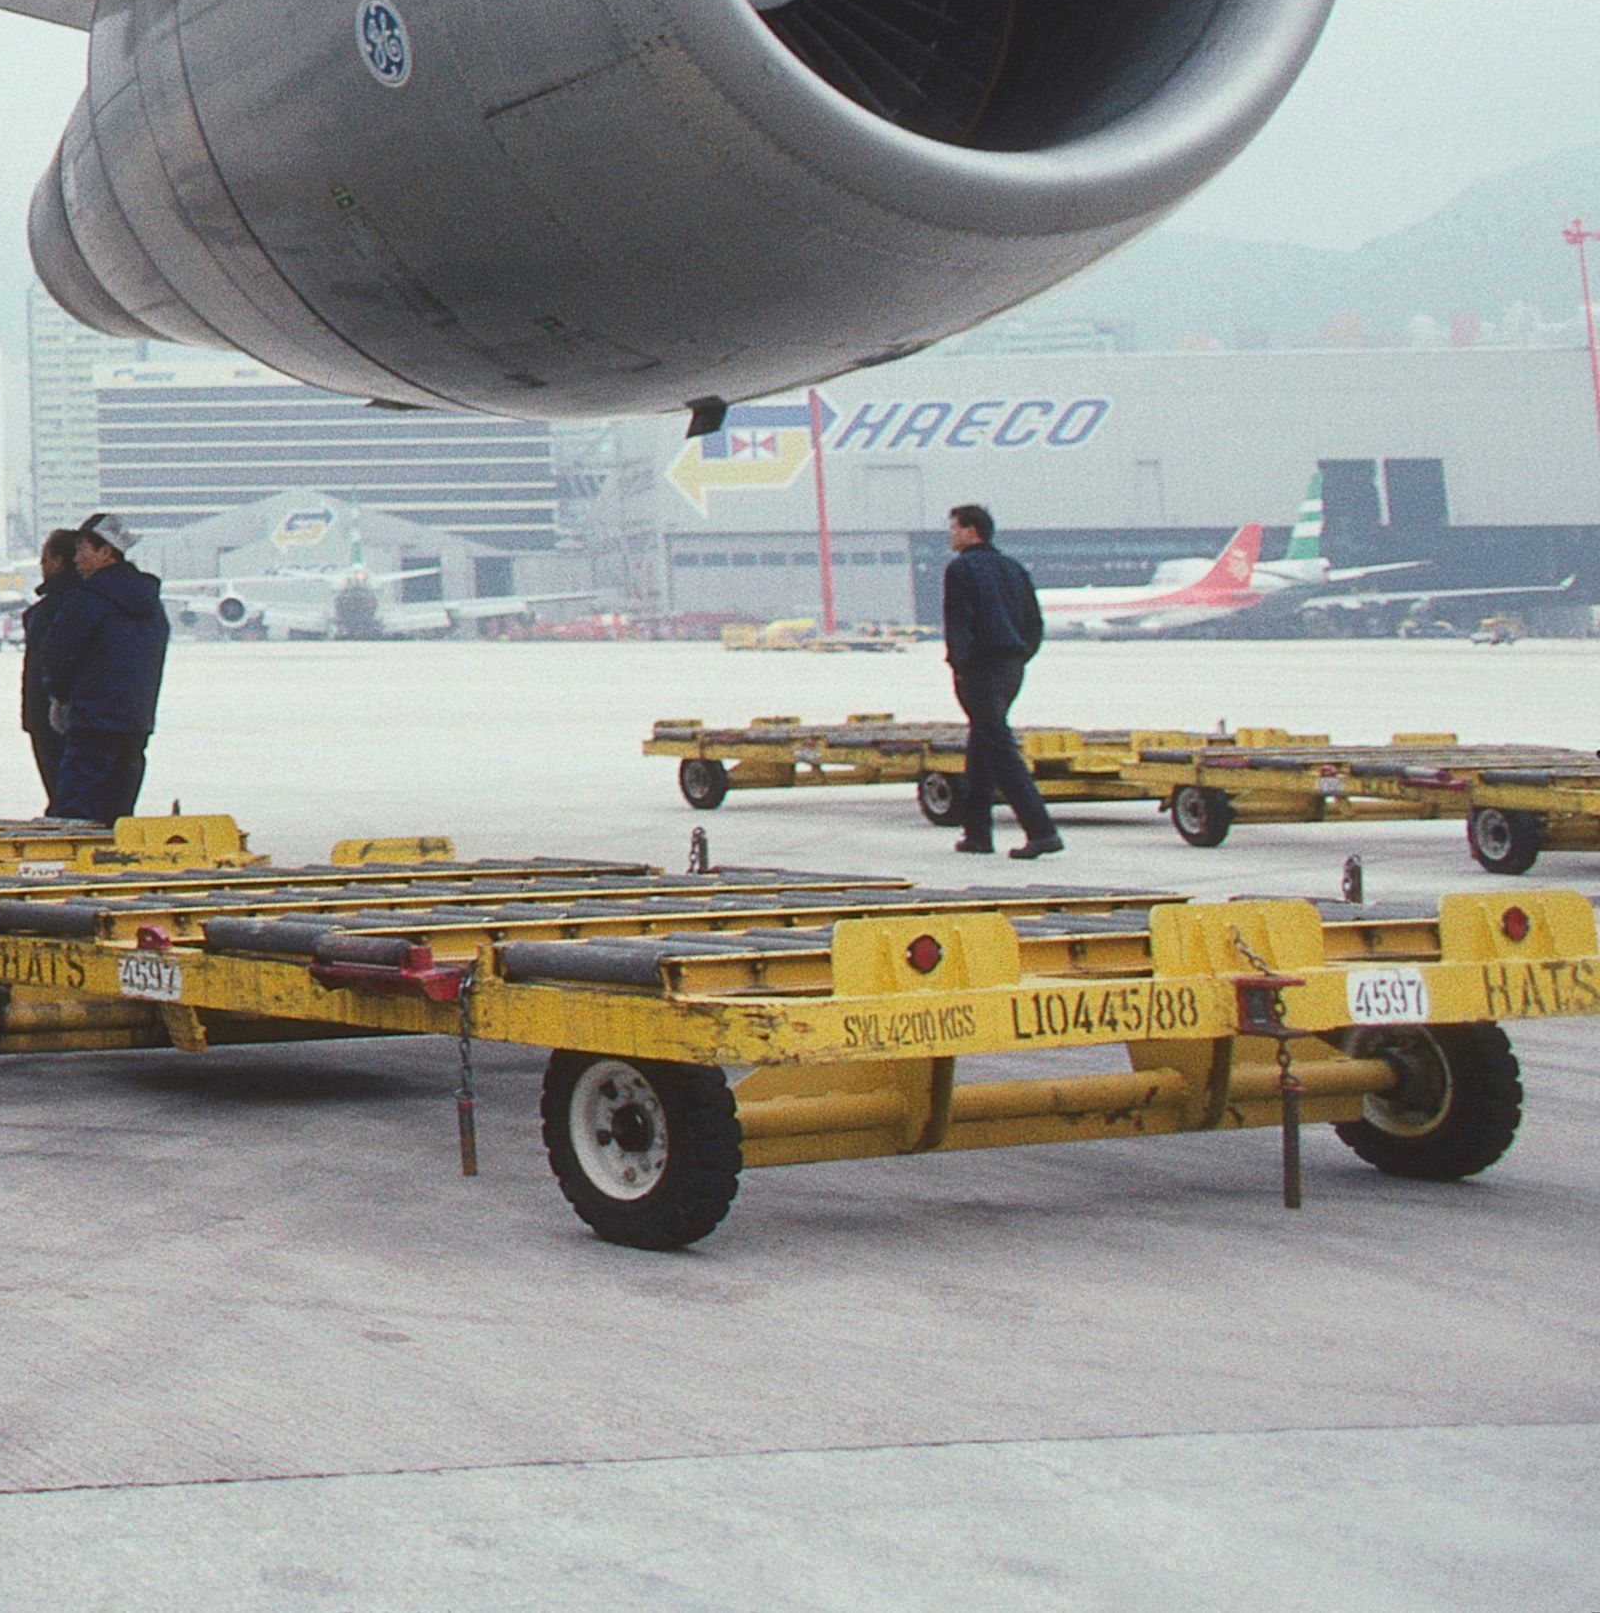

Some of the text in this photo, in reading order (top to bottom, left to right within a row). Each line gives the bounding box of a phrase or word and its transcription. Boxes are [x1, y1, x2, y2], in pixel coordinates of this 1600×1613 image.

[833, 399, 1110, 449] HAECO
[122, 957, 176, 995] 4597
[1482, 959, 1600, 1017] HATS
[1355, 978, 1424, 1017] 4597
[938, 1004, 976, 1040] KGS
